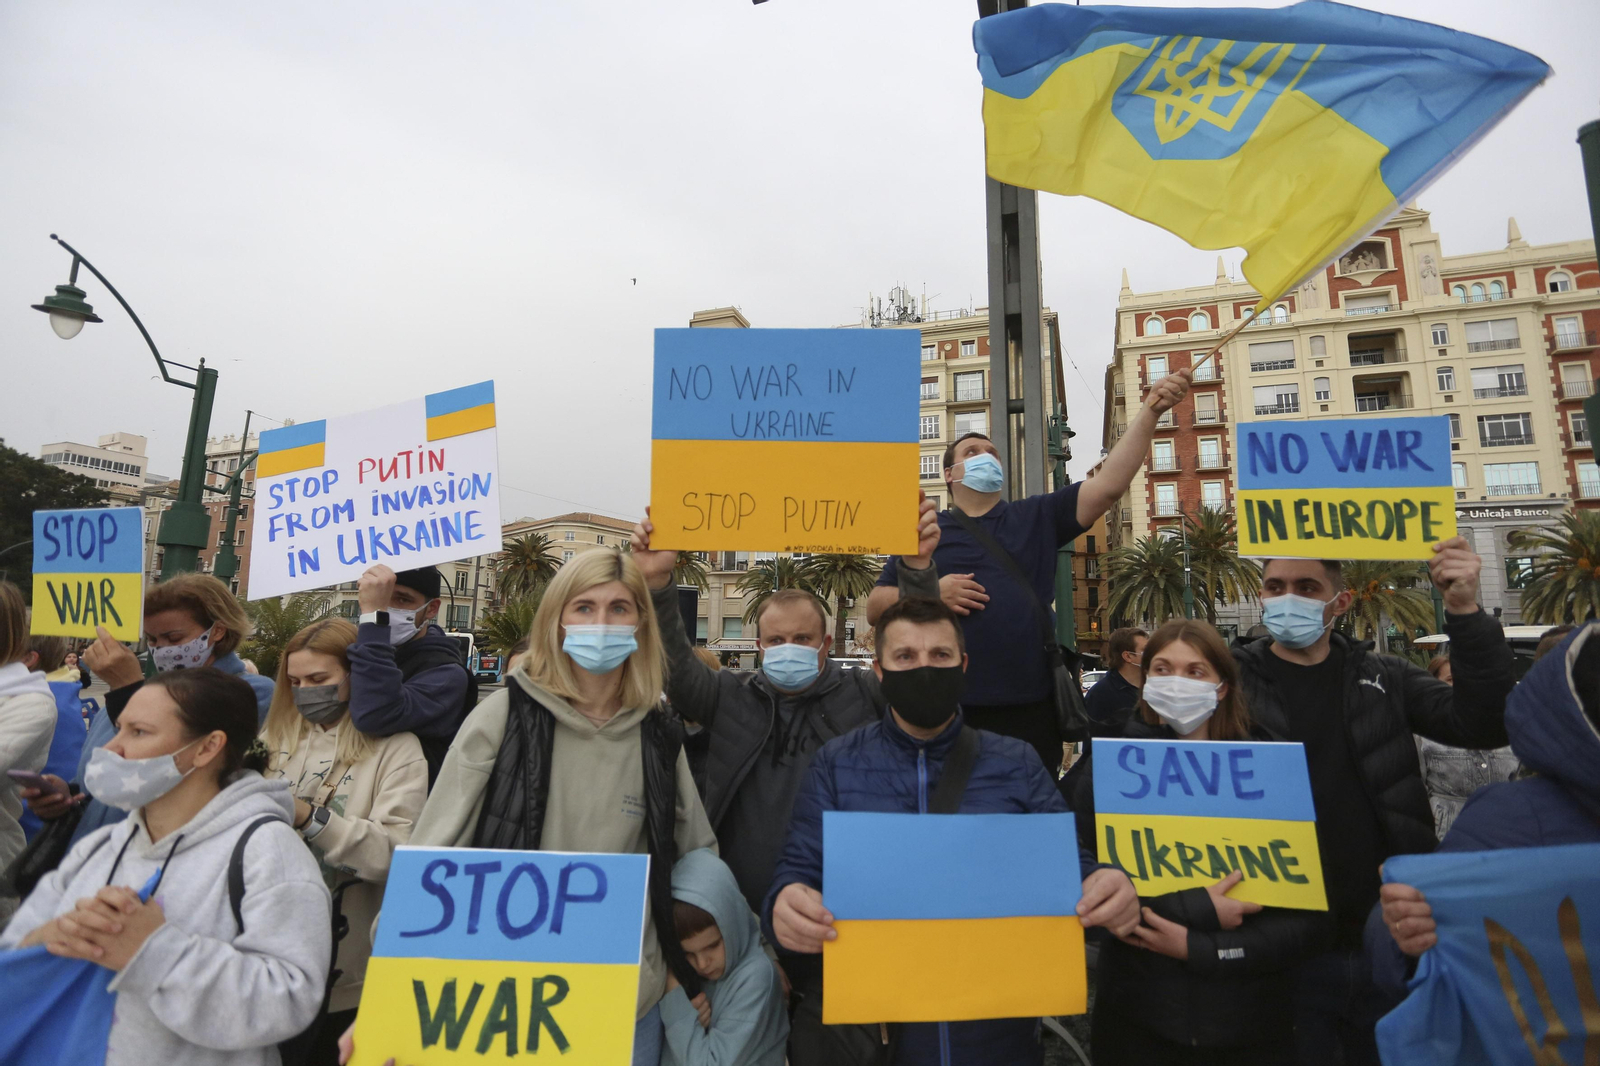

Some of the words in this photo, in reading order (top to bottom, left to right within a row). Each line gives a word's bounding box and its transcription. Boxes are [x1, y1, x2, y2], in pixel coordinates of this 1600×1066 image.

[669, 364, 712, 401] NO
[730, 363, 803, 401] WAR
[828, 367, 856, 394] IN
[730, 410, 835, 438] UKRAINE
[1247, 431, 1309, 477] NO
[1320, 429, 1434, 473] WAR
[268, 469, 339, 510] STOP
[268, 498, 355, 542] FROM
[682, 492, 756, 532] STOP
[783, 496, 862, 533] PUTIN
[1244, 498, 1289, 544] IN
[1293, 497, 1443, 543] EUROPE
[1469, 508, 1512, 519] Unicaja
[1513, 508, 1549, 517] Banco
[43, 512, 118, 563] STOP
[806, 545, 834, 553] VODKA
[847, 545, 881, 554] UKRAINE
[46, 578, 123, 627] WAR
[1117, 744, 1265, 800] SAVE
[400, 858, 608, 940] STOP
[412, 974, 573, 1058] WAR
